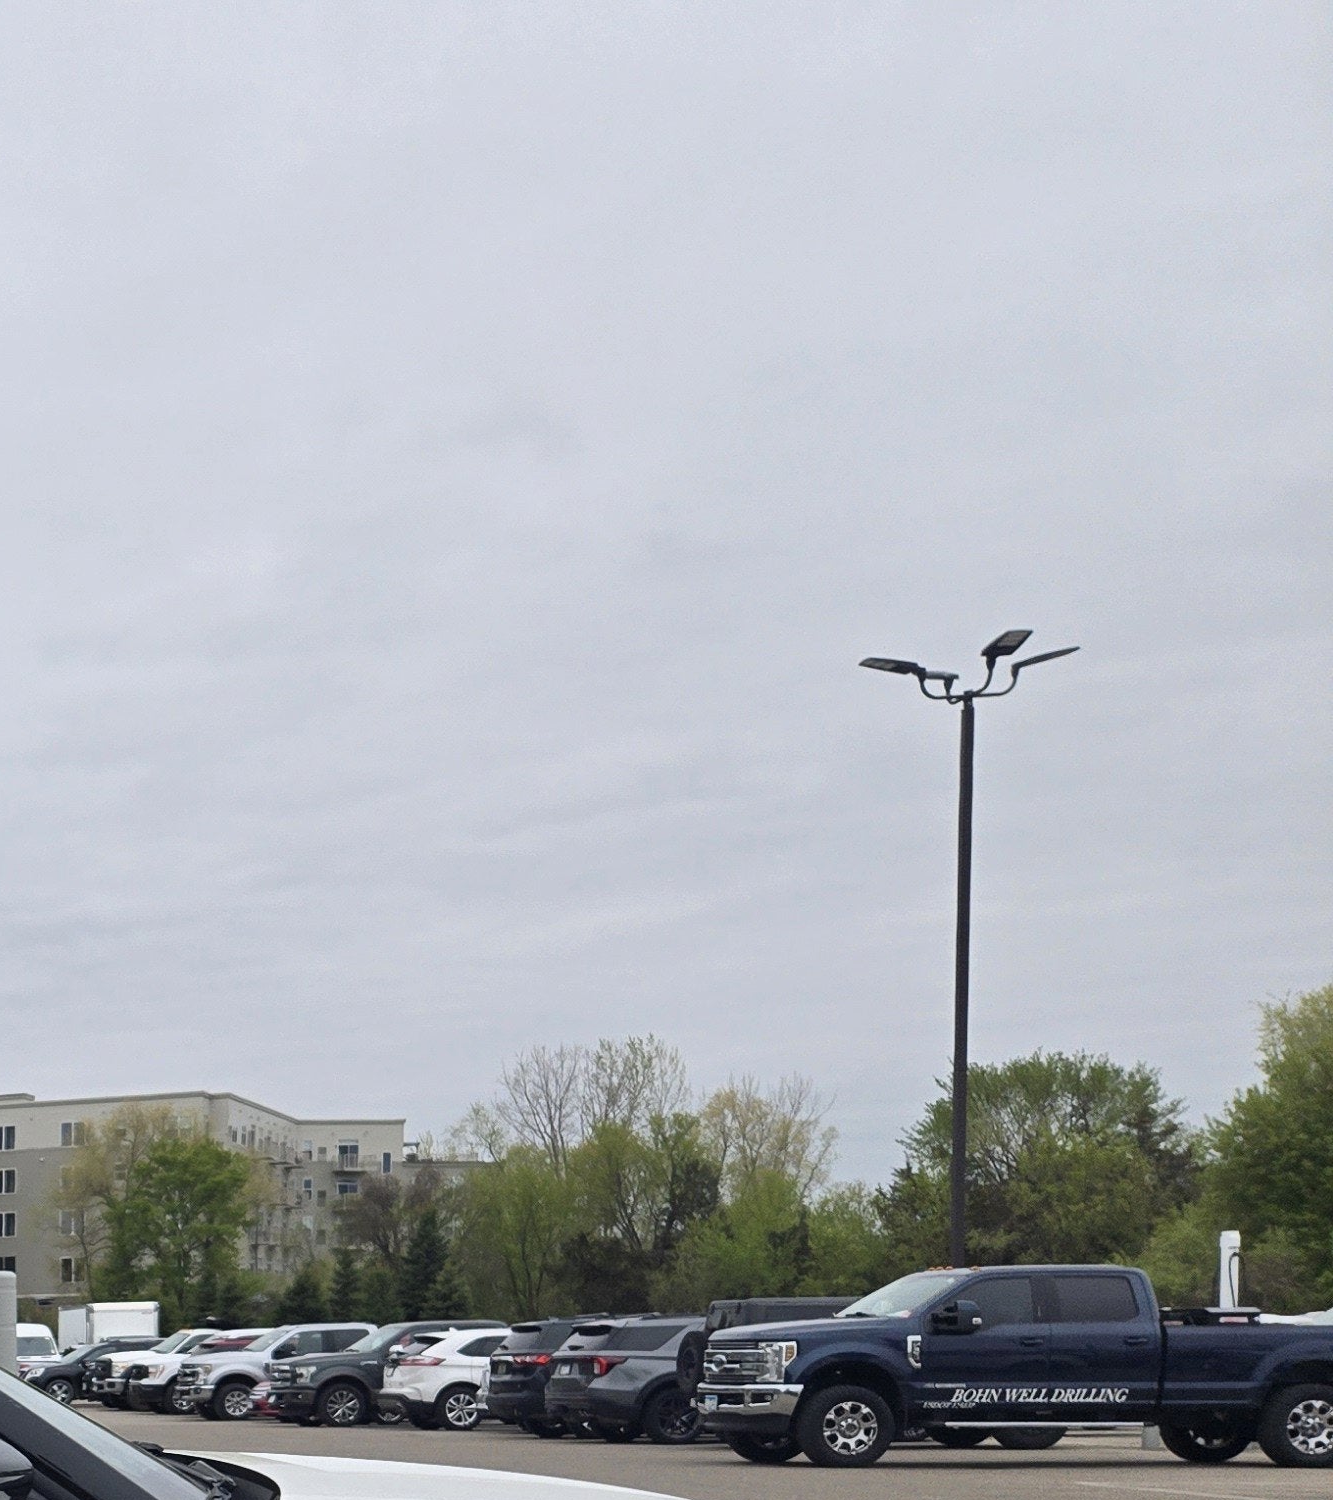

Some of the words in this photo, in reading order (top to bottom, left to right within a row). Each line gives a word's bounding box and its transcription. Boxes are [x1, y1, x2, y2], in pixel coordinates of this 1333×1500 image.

[950, 1388, 1002, 1404] BOHN
[1004, 1388, 1049, 1404] WELL
[1050, 1388, 1129, 1404] DRILLING
